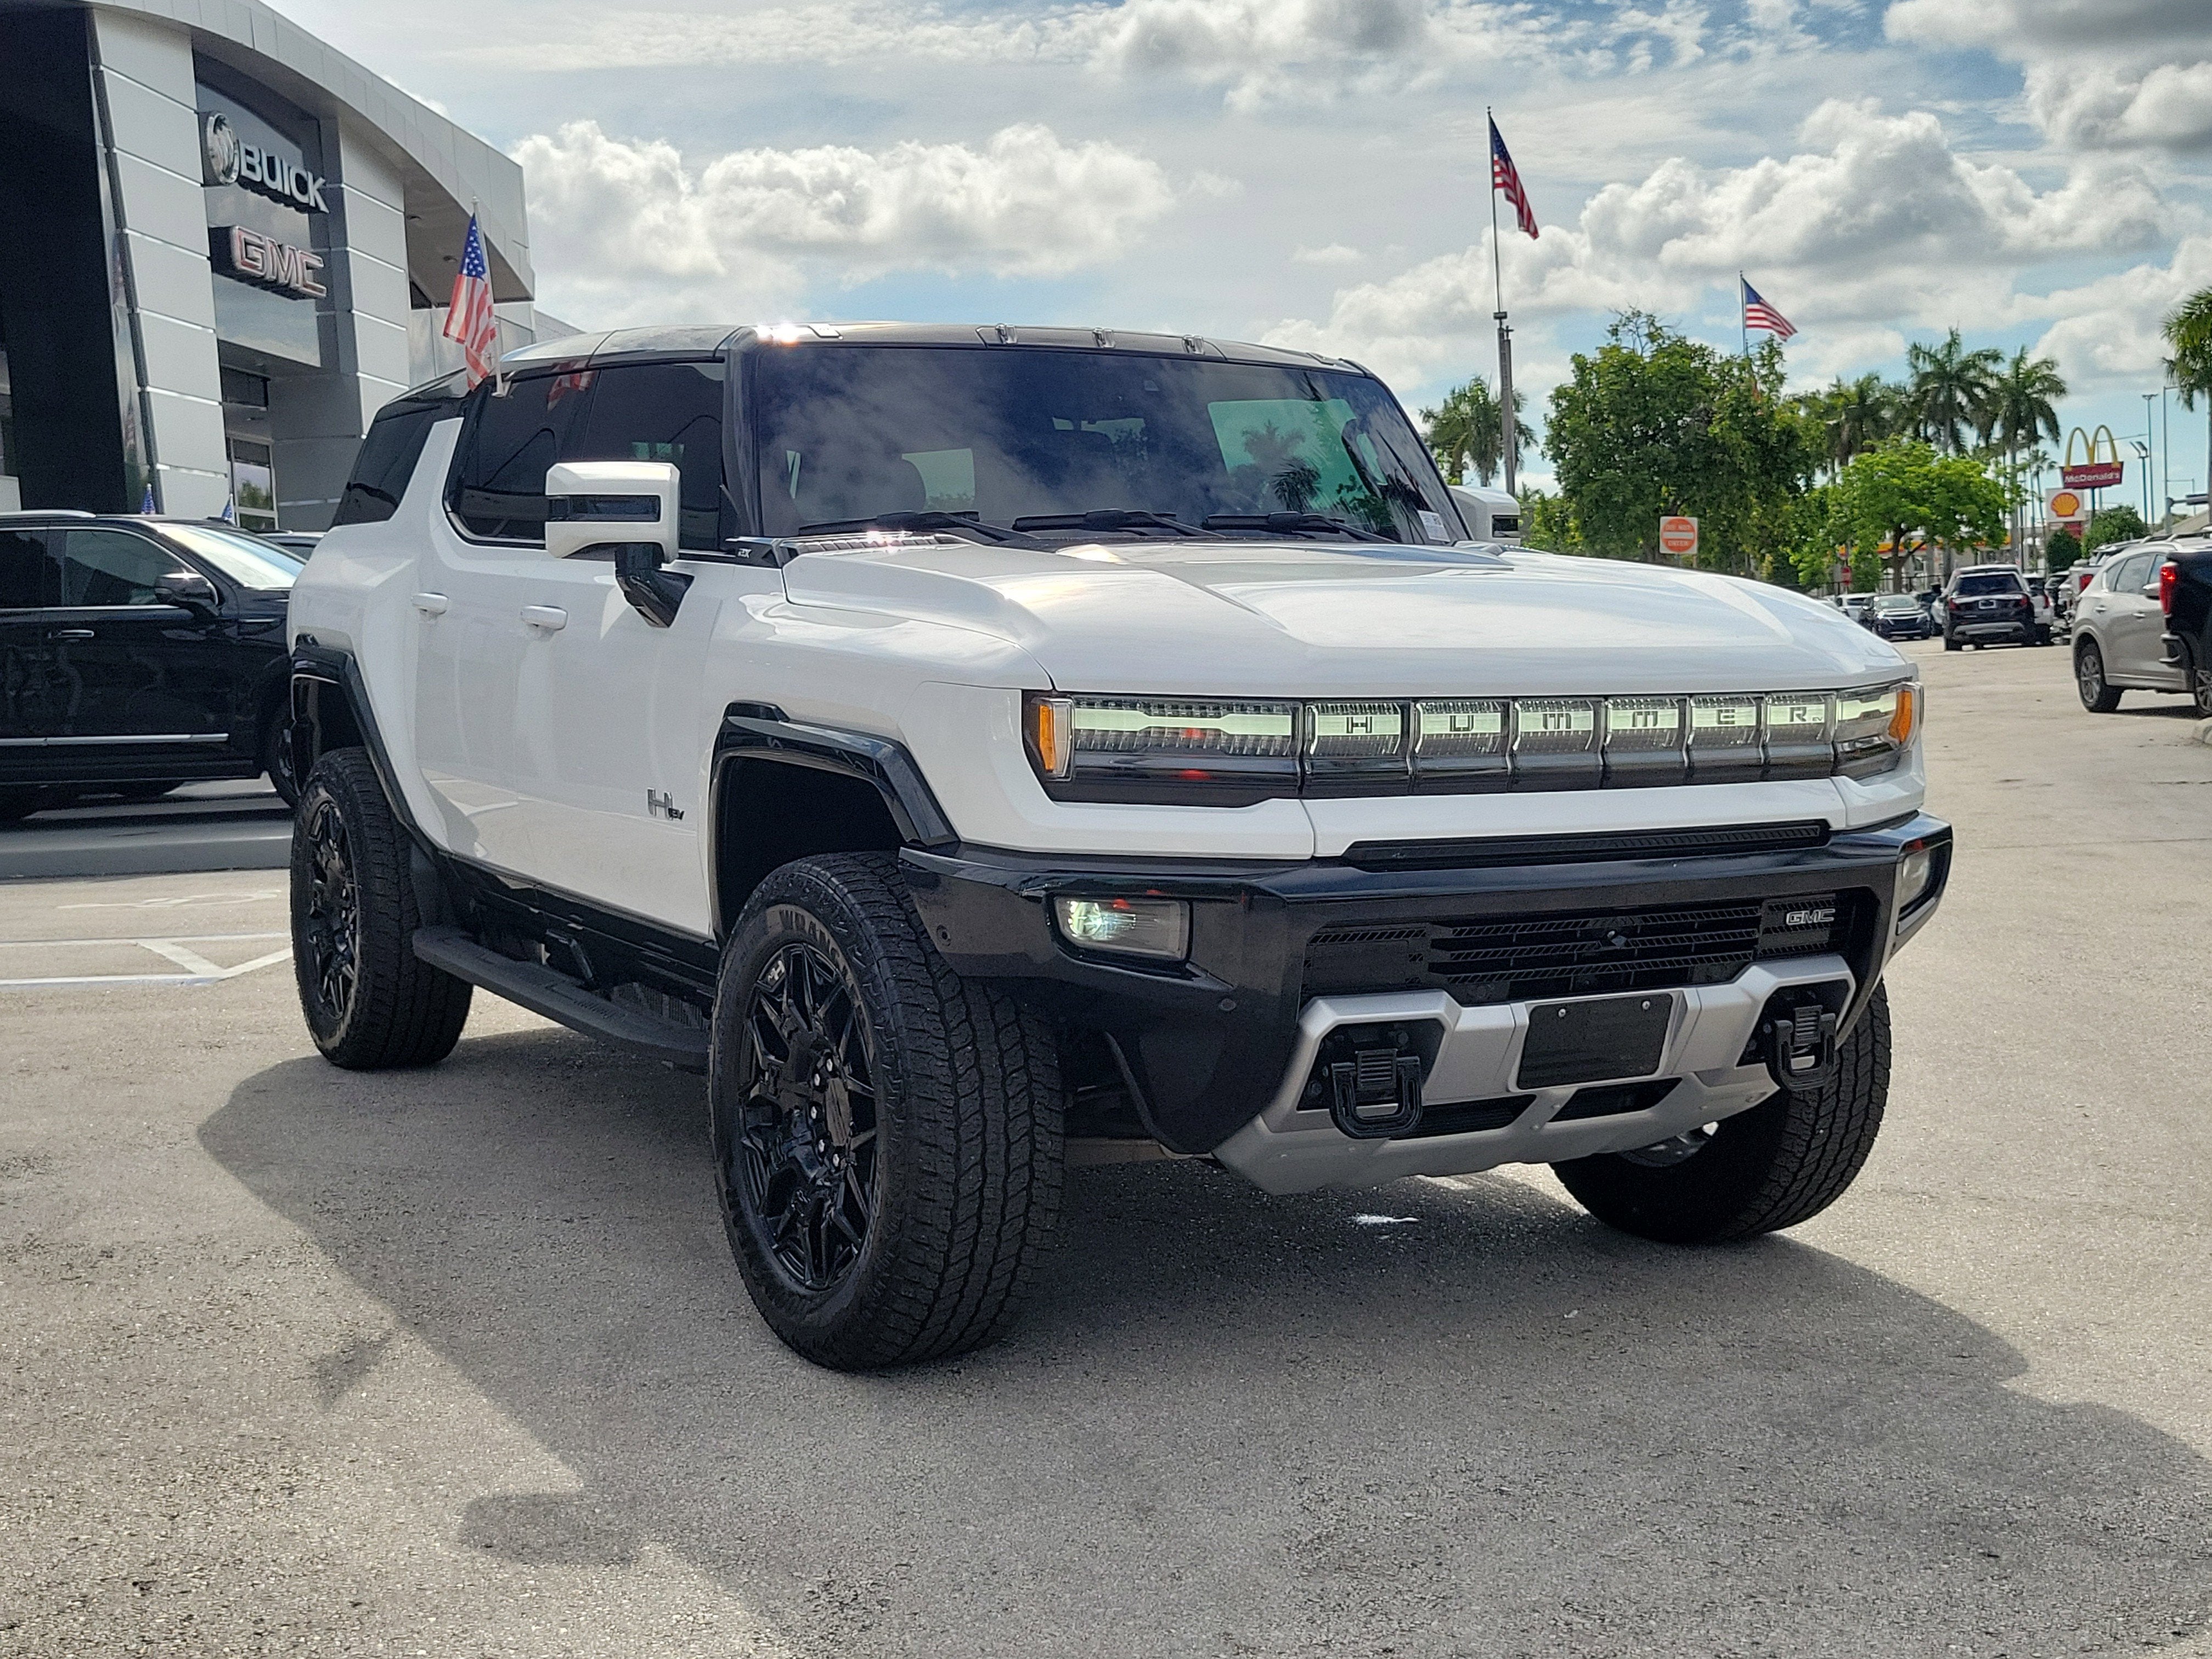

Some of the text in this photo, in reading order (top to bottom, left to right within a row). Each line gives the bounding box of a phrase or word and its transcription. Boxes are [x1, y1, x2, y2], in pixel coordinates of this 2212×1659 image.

[240, 142, 330, 213] BUICK
[232, 225, 328, 298] GMC
[2064, 472, 2120, 483] McDonald's
[1346, 706, 1807, 734] HUMMER
[1786, 908, 1836, 926] GMC
